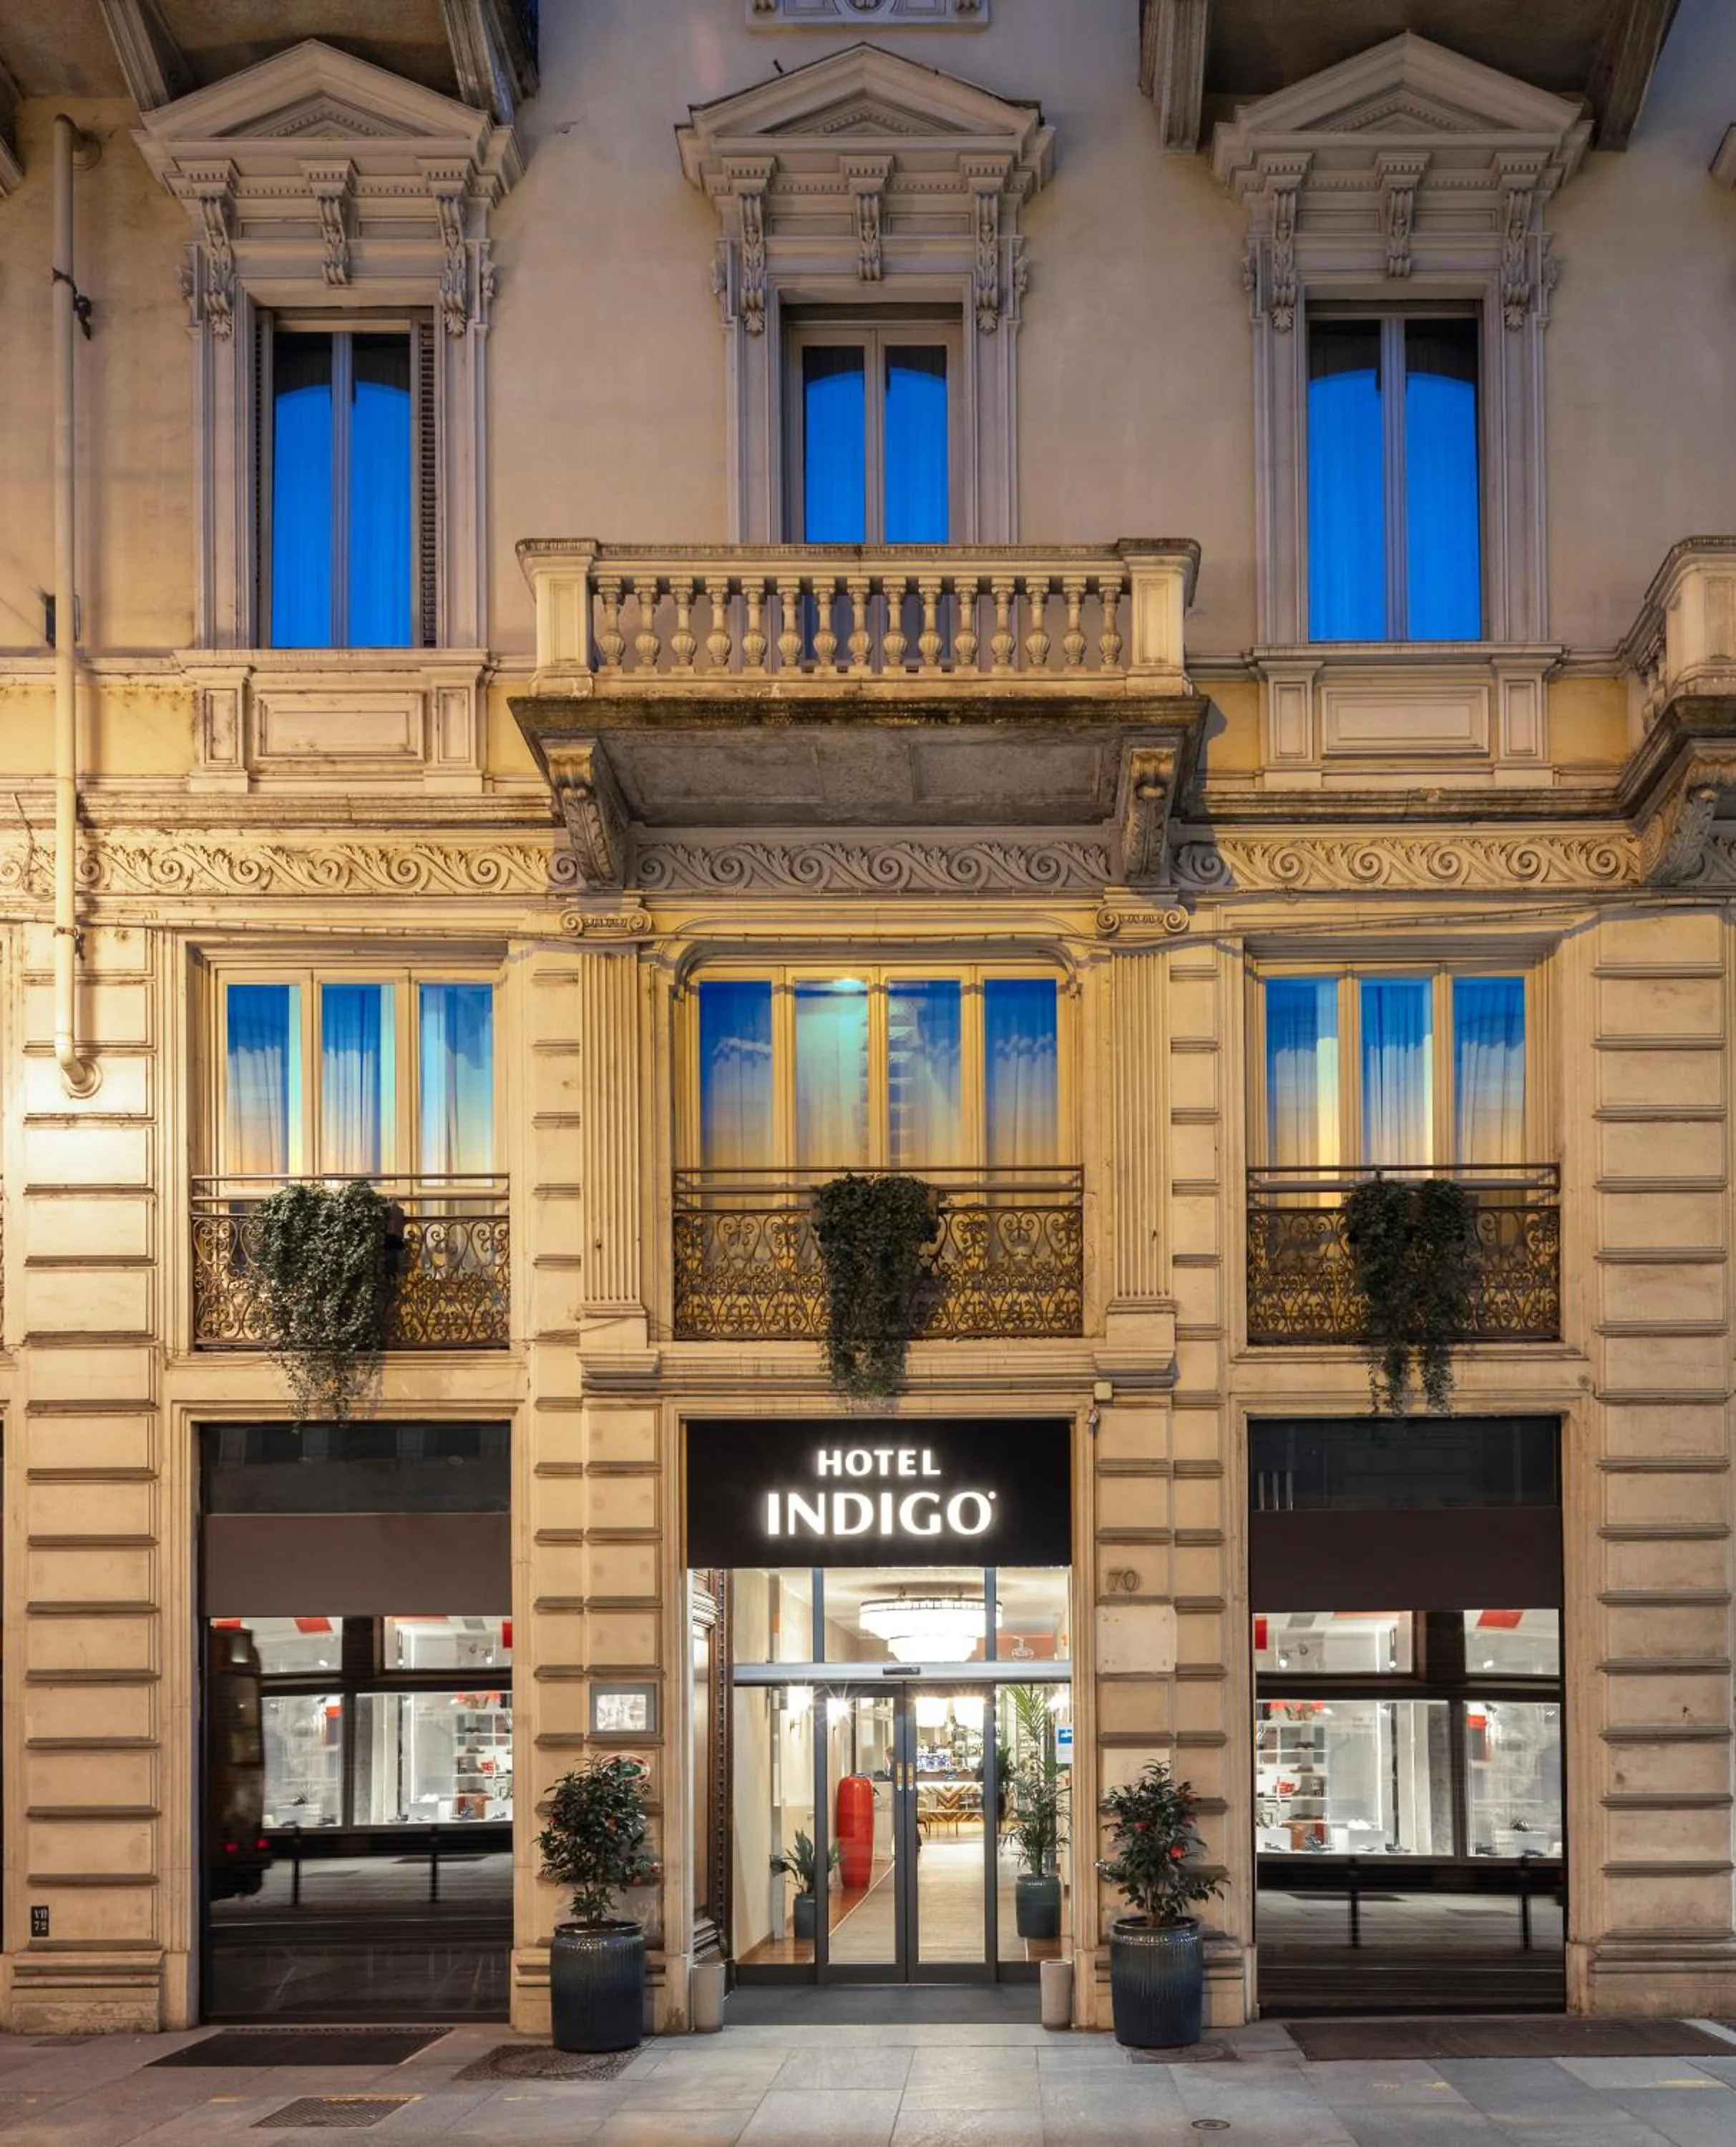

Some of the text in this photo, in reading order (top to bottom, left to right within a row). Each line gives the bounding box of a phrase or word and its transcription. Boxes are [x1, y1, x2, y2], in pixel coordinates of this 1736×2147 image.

[818, 1449, 942, 1476] HOTEL
[767, 1491, 993, 1537] INDIGO
[1107, 1569, 1139, 1592] 70
